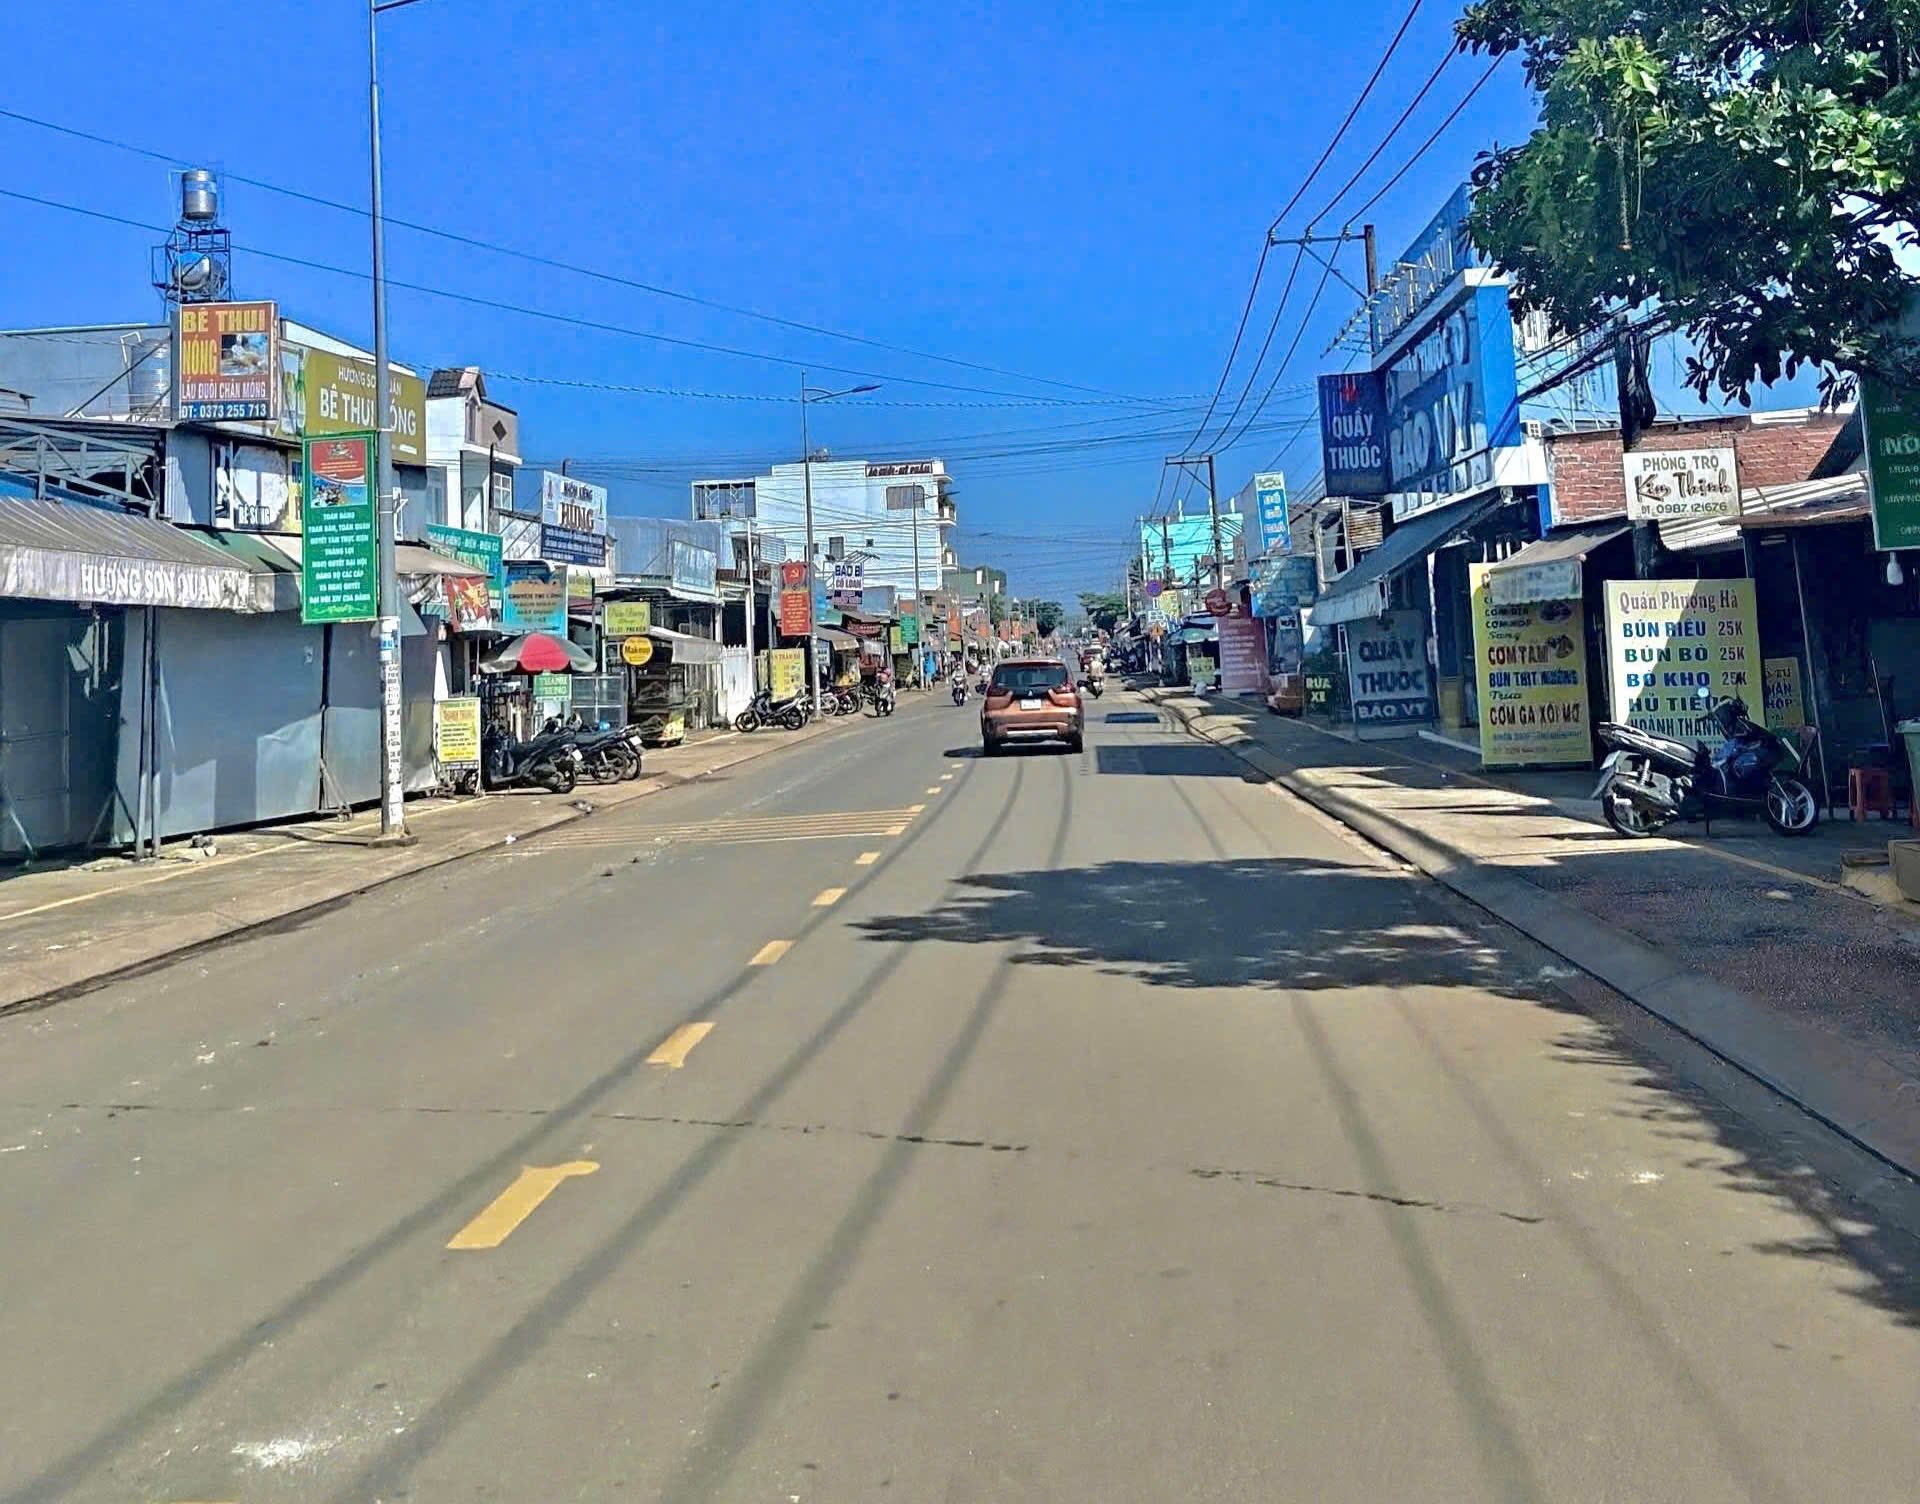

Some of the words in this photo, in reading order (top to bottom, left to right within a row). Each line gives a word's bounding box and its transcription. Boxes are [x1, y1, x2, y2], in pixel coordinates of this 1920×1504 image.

[183, 307, 209, 333] BÊ
[215, 309, 266, 332] THUI
[182, 334, 218, 375] NÓNG
[200, 404, 224, 418] 0373
[227, 404, 245, 417] 255
[249, 403, 267, 417] 713
[320, 383, 339, 420] BÊ
[1332, 407, 1374, 441] QUẦY
[1328, 437, 1381, 470] THUỐC
[1642, 452, 1686, 472] PHÒNG
[1692, 455, 1719, 472] TRỌ
[1673, 468, 1732, 499] Thịnh
[1619, 590, 1658, 614] Quán
[1661, 591, 1716, 614] Phượng
[1720, 589, 1738, 609] Hà
[1623, 619, 1659, 638] BÚN
[1665, 618, 1706, 637] RIÊU
[1718, 621, 1743, 636] 25K
[1625, 645, 1671, 663] BÚN
[1678, 643, 1708, 662] BÒ
[1720, 646, 1744, 661] 25K
[1627, 670, 1657, 687] BÒ
[1664, 671, 1710, 687] KHO
[1722, 671, 1747, 686] 25K
[1311, 692, 1326, 702] XE
[1629, 692, 1659, 712] HỦ
